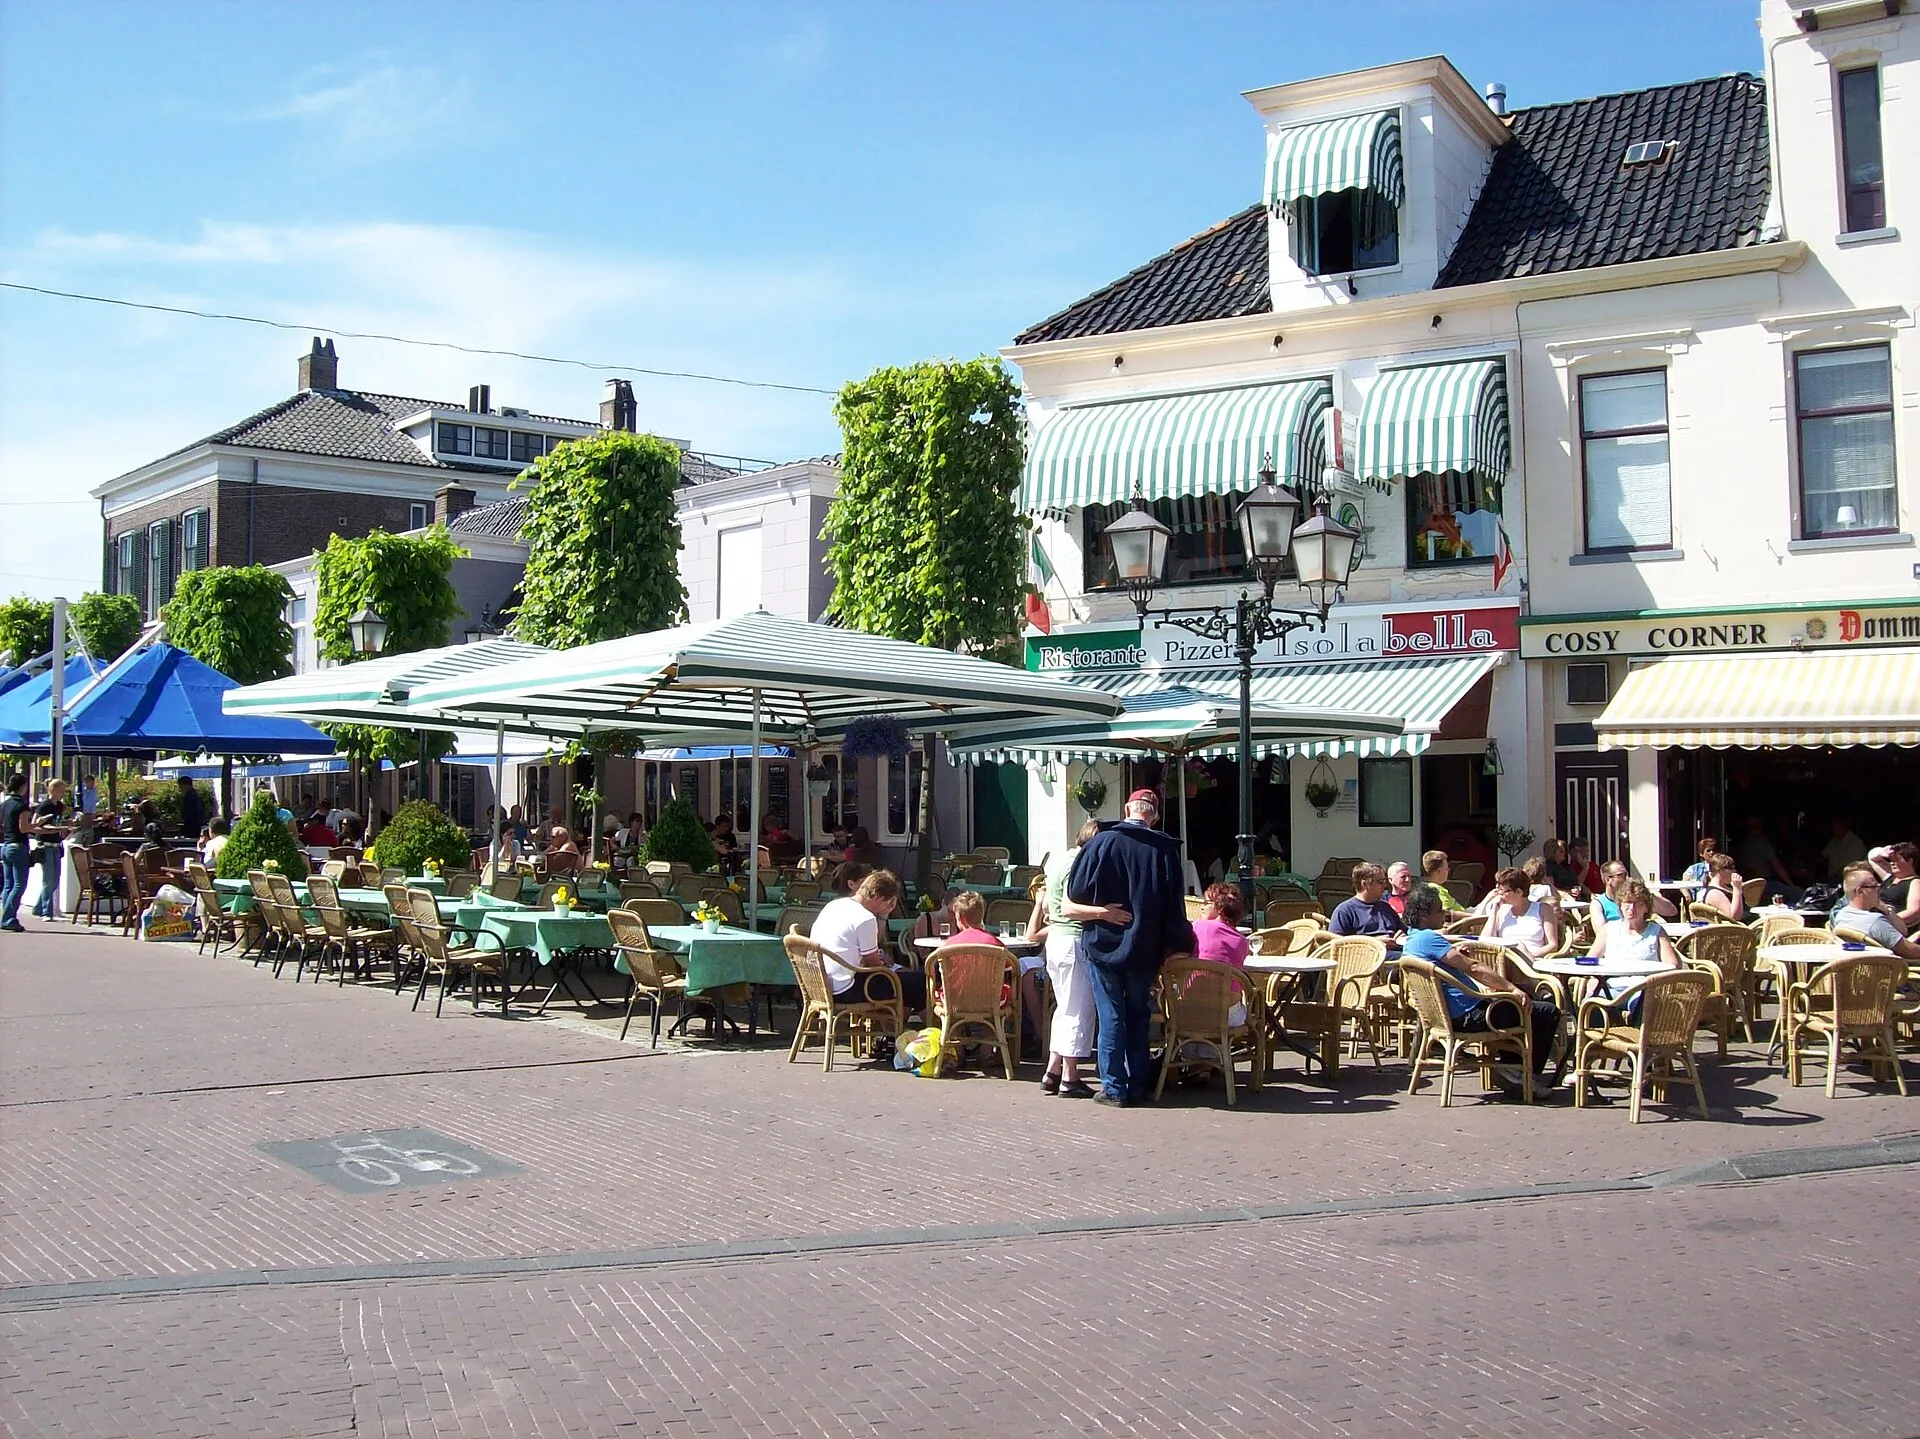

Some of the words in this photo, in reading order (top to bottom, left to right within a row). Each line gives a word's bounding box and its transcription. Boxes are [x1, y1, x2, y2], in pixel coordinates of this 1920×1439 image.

[1545, 630, 1620, 653] COSY
[1649, 624, 1768, 648] CORNER
[1040, 645, 1147, 668] Ristorante
[1164, 639, 1242, 662] Pizzer
